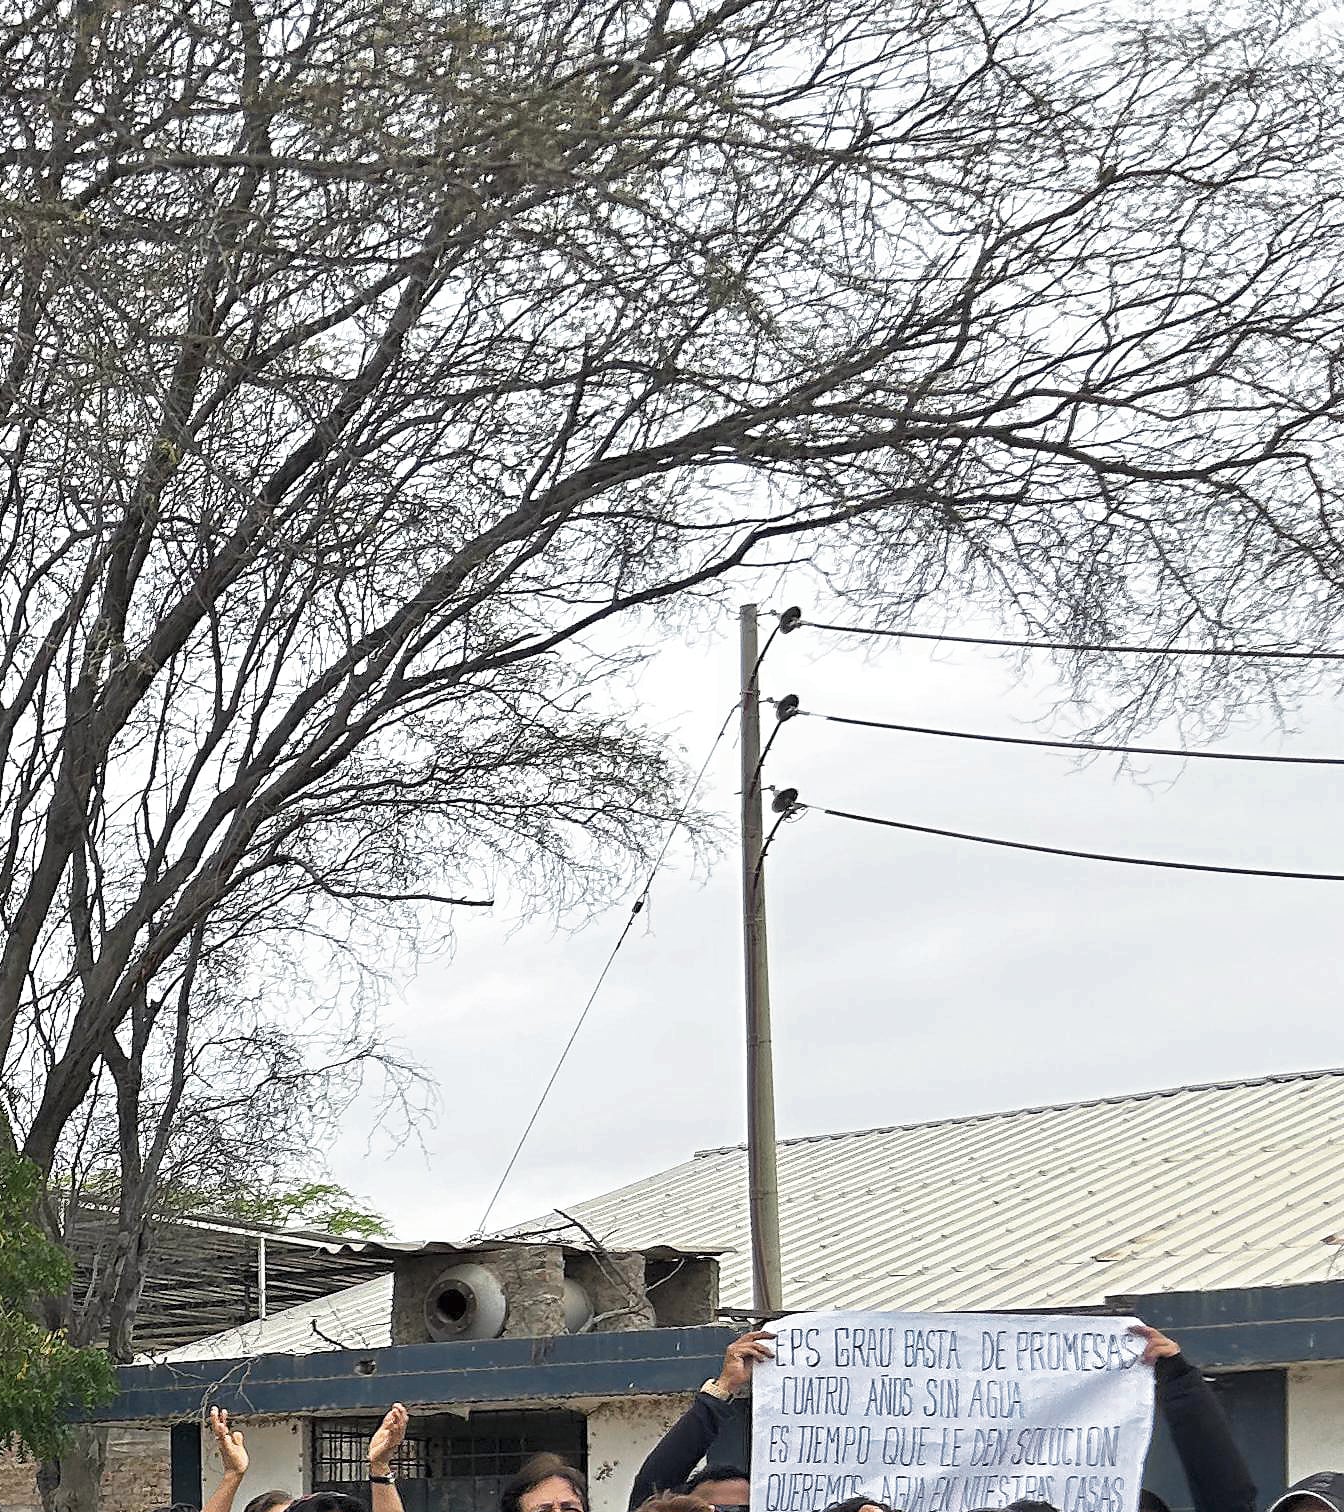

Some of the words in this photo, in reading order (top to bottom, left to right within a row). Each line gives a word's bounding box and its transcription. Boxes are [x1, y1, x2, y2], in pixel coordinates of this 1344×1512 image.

[776, 1328, 821, 1368] EPS
[835, 1328, 894, 1368] GRAU
[904, 1329, 962, 1370] BASTA
[981, 1331, 1008, 1371] DE
[1016, 1332, 1138, 1371] PROMESAS
[781, 1376, 850, 1416] CUATRO
[864, 1374, 913, 1416] AÑOS
[923, 1378, 959, 1418] SIN
[967, 1380, 1025, 1419] AGUA
[769, 1425, 790, 1463] ES
[797, 1425, 872, 1465] TIEMPO
[882, 1426, 931, 1467] QUE
[940, 1427, 965, 1467] LE
[970, 1428, 1012, 1467] DEN
